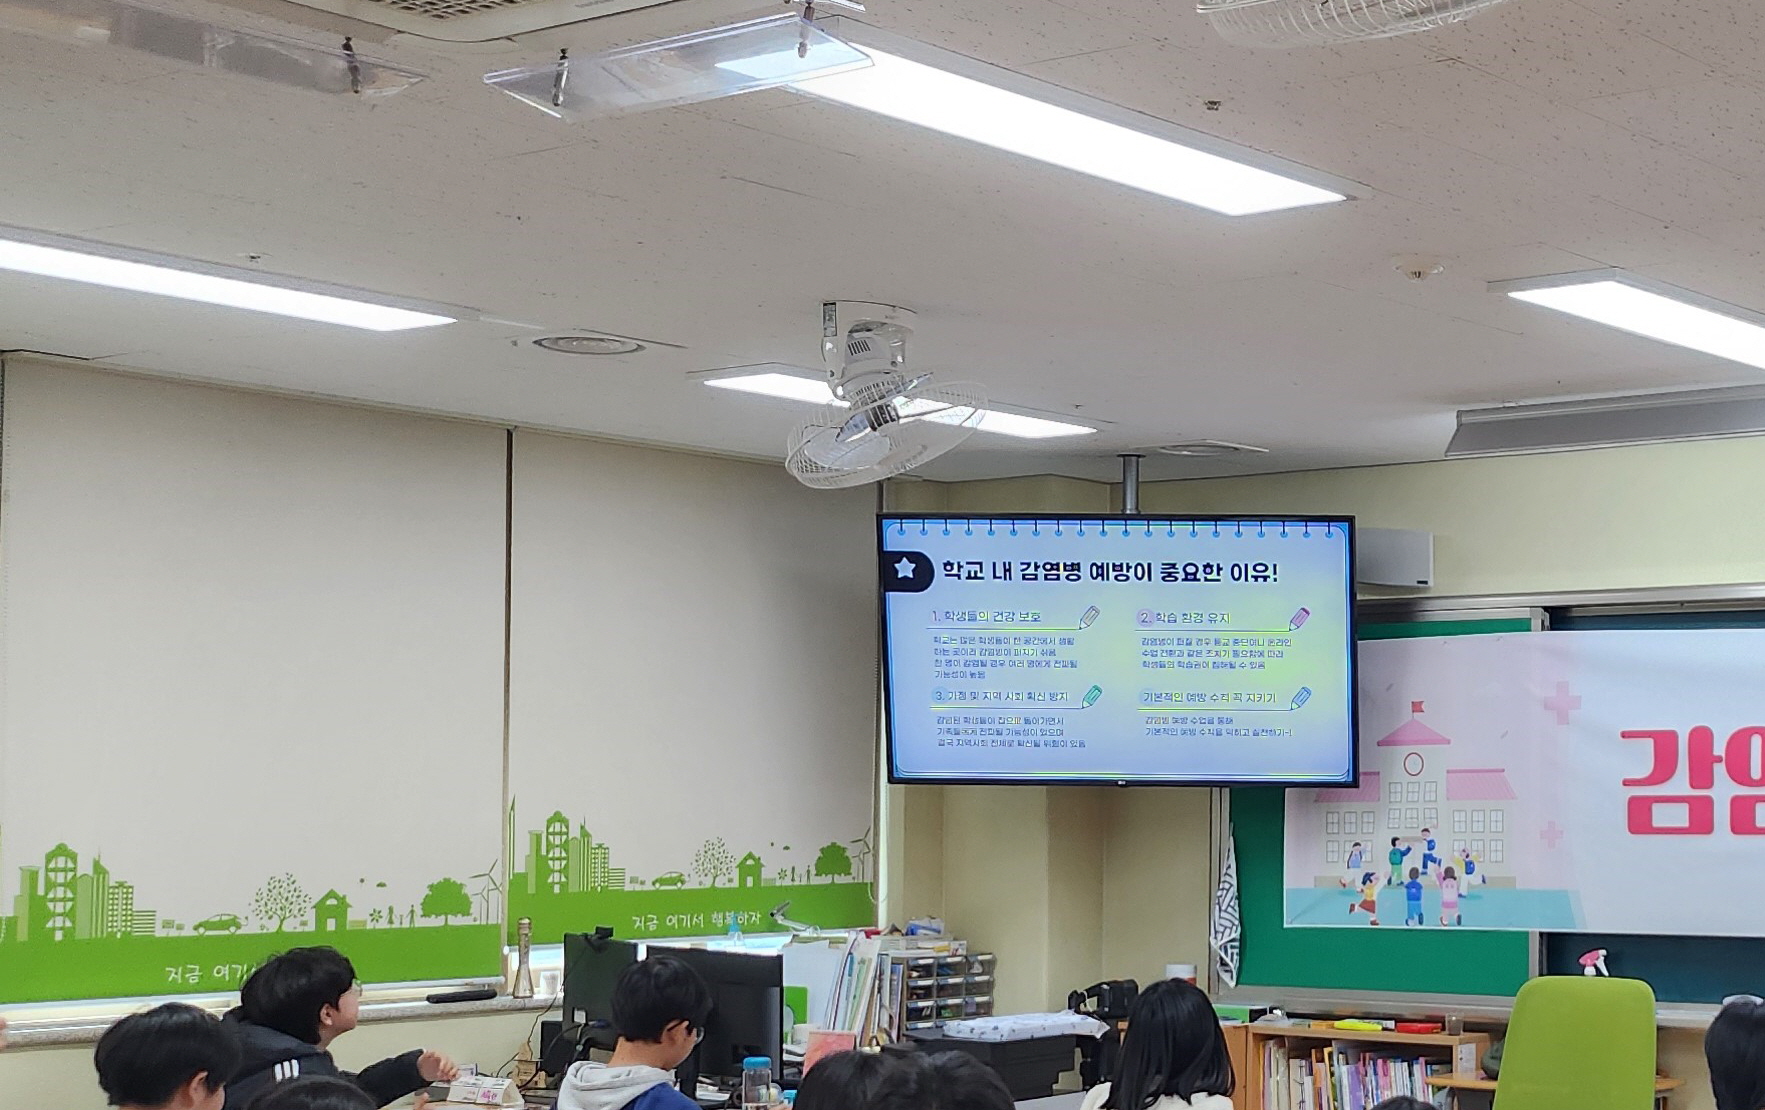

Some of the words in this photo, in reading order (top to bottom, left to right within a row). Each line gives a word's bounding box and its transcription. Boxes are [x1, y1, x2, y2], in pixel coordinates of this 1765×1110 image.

[942, 560, 985, 581] 학교
[992, 561, 1013, 581] 내
[1019, 561, 1082, 582] 감염병
[1089, 562, 1152, 582] 예방이
[1160, 562, 1223, 583] 중요한
[1230, 562, 1279, 583] 이유!
[932, 610, 941, 622] 1.
[944, 610, 989, 622] 학생들의
[993, 610, 1015, 622] 건강
[1019, 610, 1041, 622] 보호
[1140, 612, 1152, 624] 2.
[1156, 612, 1178, 624] 학습
[1182, 612, 1204, 624] 환경
[1208, 612, 1231, 624] 유지
[982, 691, 1001, 702] 지역
[1005, 691, 1024, 702] 사회
[1049, 691, 1069, 702] 방지
[1144, 692, 1183, 703] 기본적인
[1186, 692, 1207, 703] 예방
[1246, 692, 1276, 703] 지키기
[632, 914, 659, 931] 지금
[666, 912, 704, 928] 여기서
[165, 965, 203, 984] 지금
